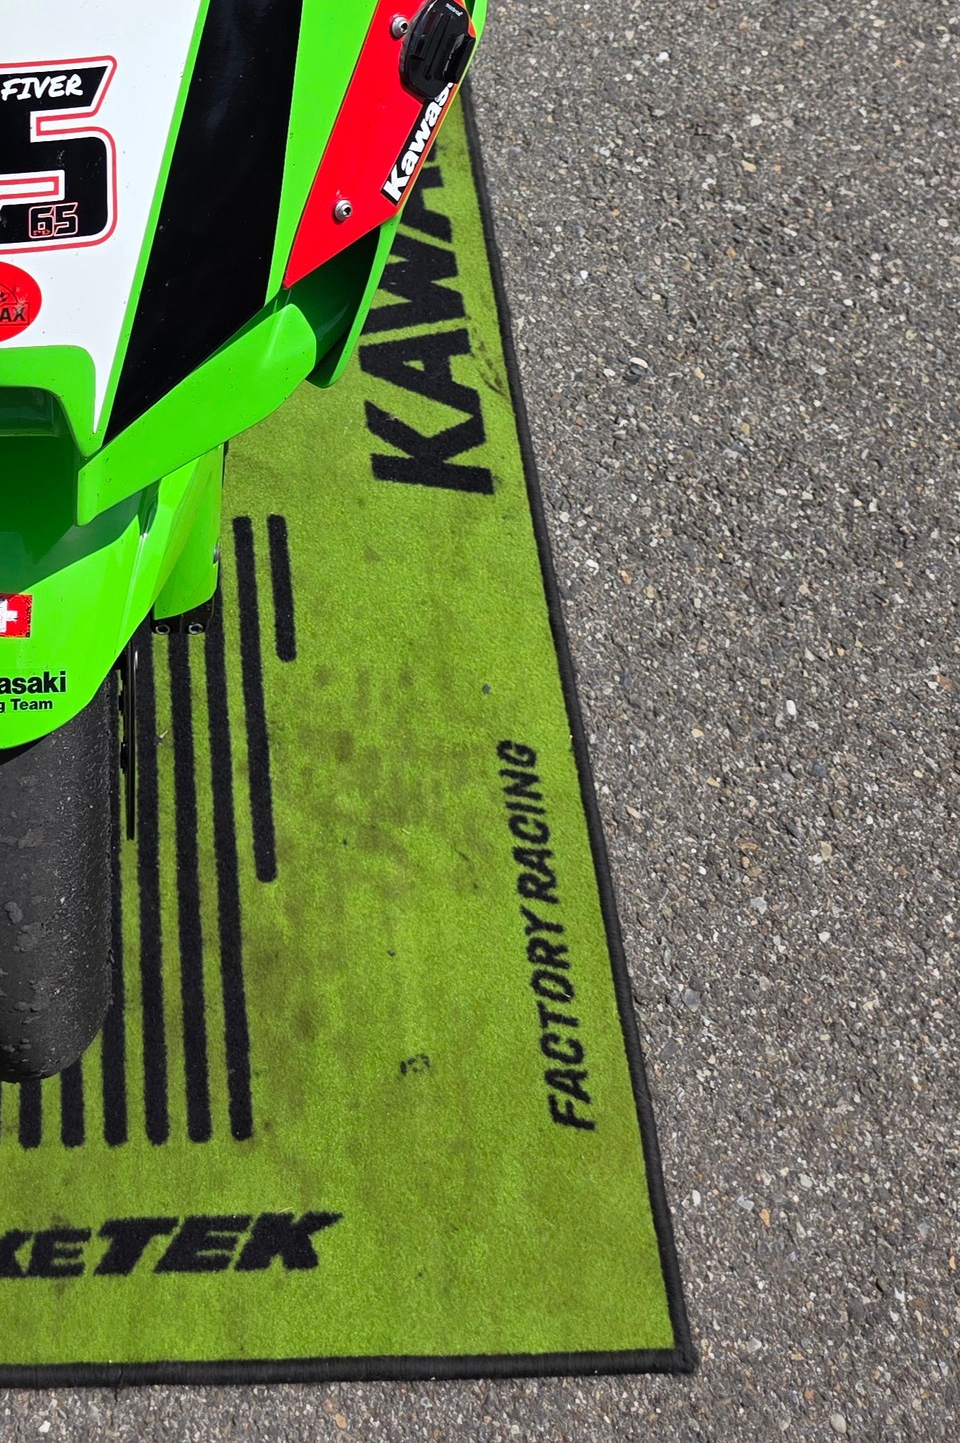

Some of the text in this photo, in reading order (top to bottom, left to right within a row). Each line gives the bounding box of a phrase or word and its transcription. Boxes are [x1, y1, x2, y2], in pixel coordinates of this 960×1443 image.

[0, 74, 83, 100] FIVER
[383, 81, 454, 202] Kawas
[28, 202, 79, 239] 65
[10, 698, 53, 710] Team
[496, 739, 596, 1131] FACTORY RACING
